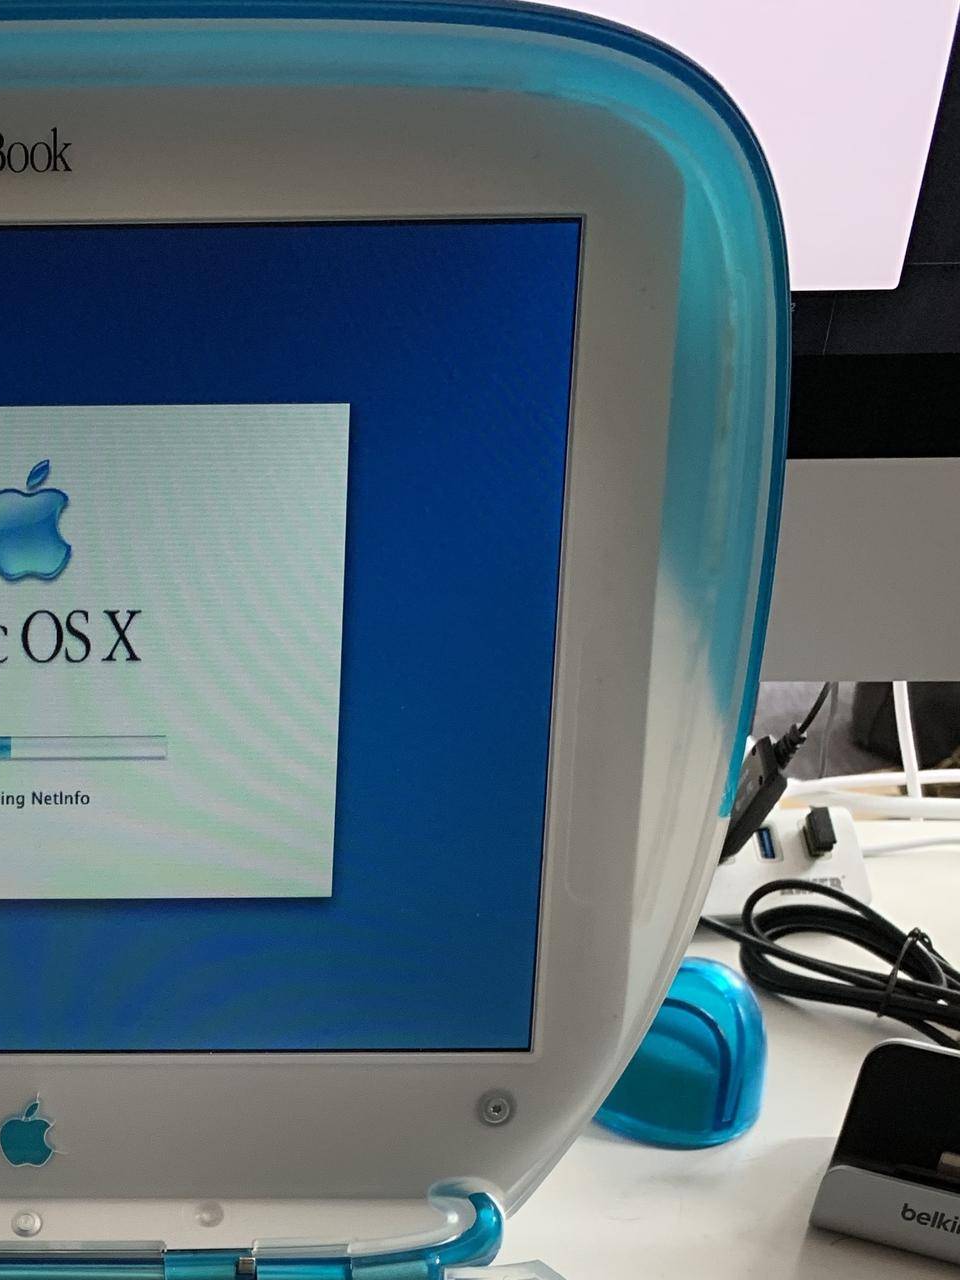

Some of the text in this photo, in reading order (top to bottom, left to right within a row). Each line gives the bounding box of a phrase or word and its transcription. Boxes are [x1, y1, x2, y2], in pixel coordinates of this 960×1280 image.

[21, 610, 91, 663] OS
[103, 609, 142, 662] X
[30, 791, 90, 806] NetInfo
